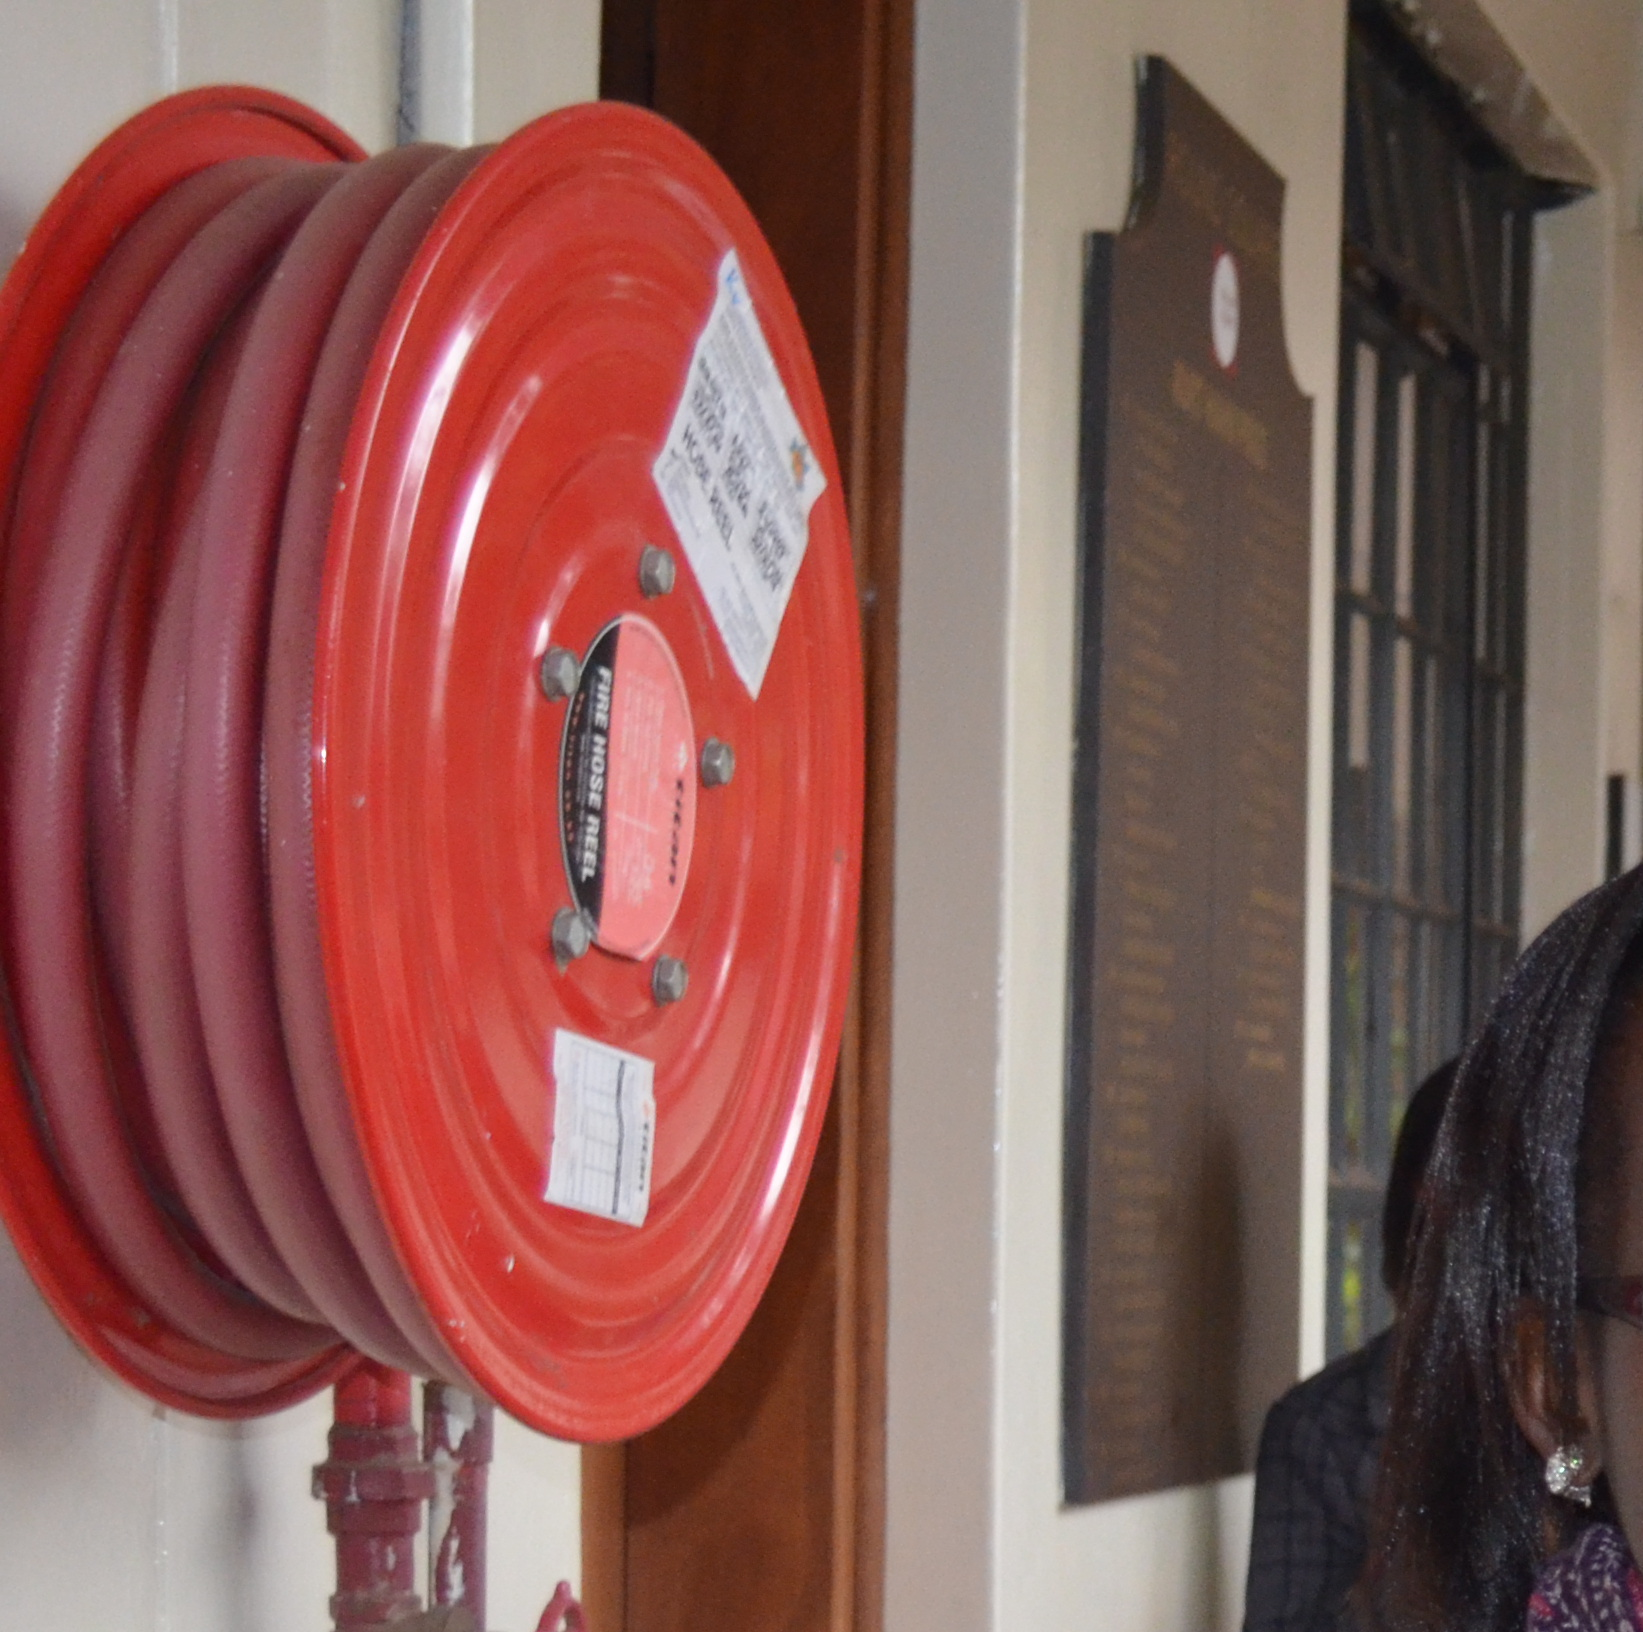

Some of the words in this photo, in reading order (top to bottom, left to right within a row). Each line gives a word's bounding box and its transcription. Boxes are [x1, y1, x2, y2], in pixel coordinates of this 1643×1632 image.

[595, 665, 613, 730] FIRE
[588, 733, 607, 811] HOSE
[580, 813, 600, 882] REEL
